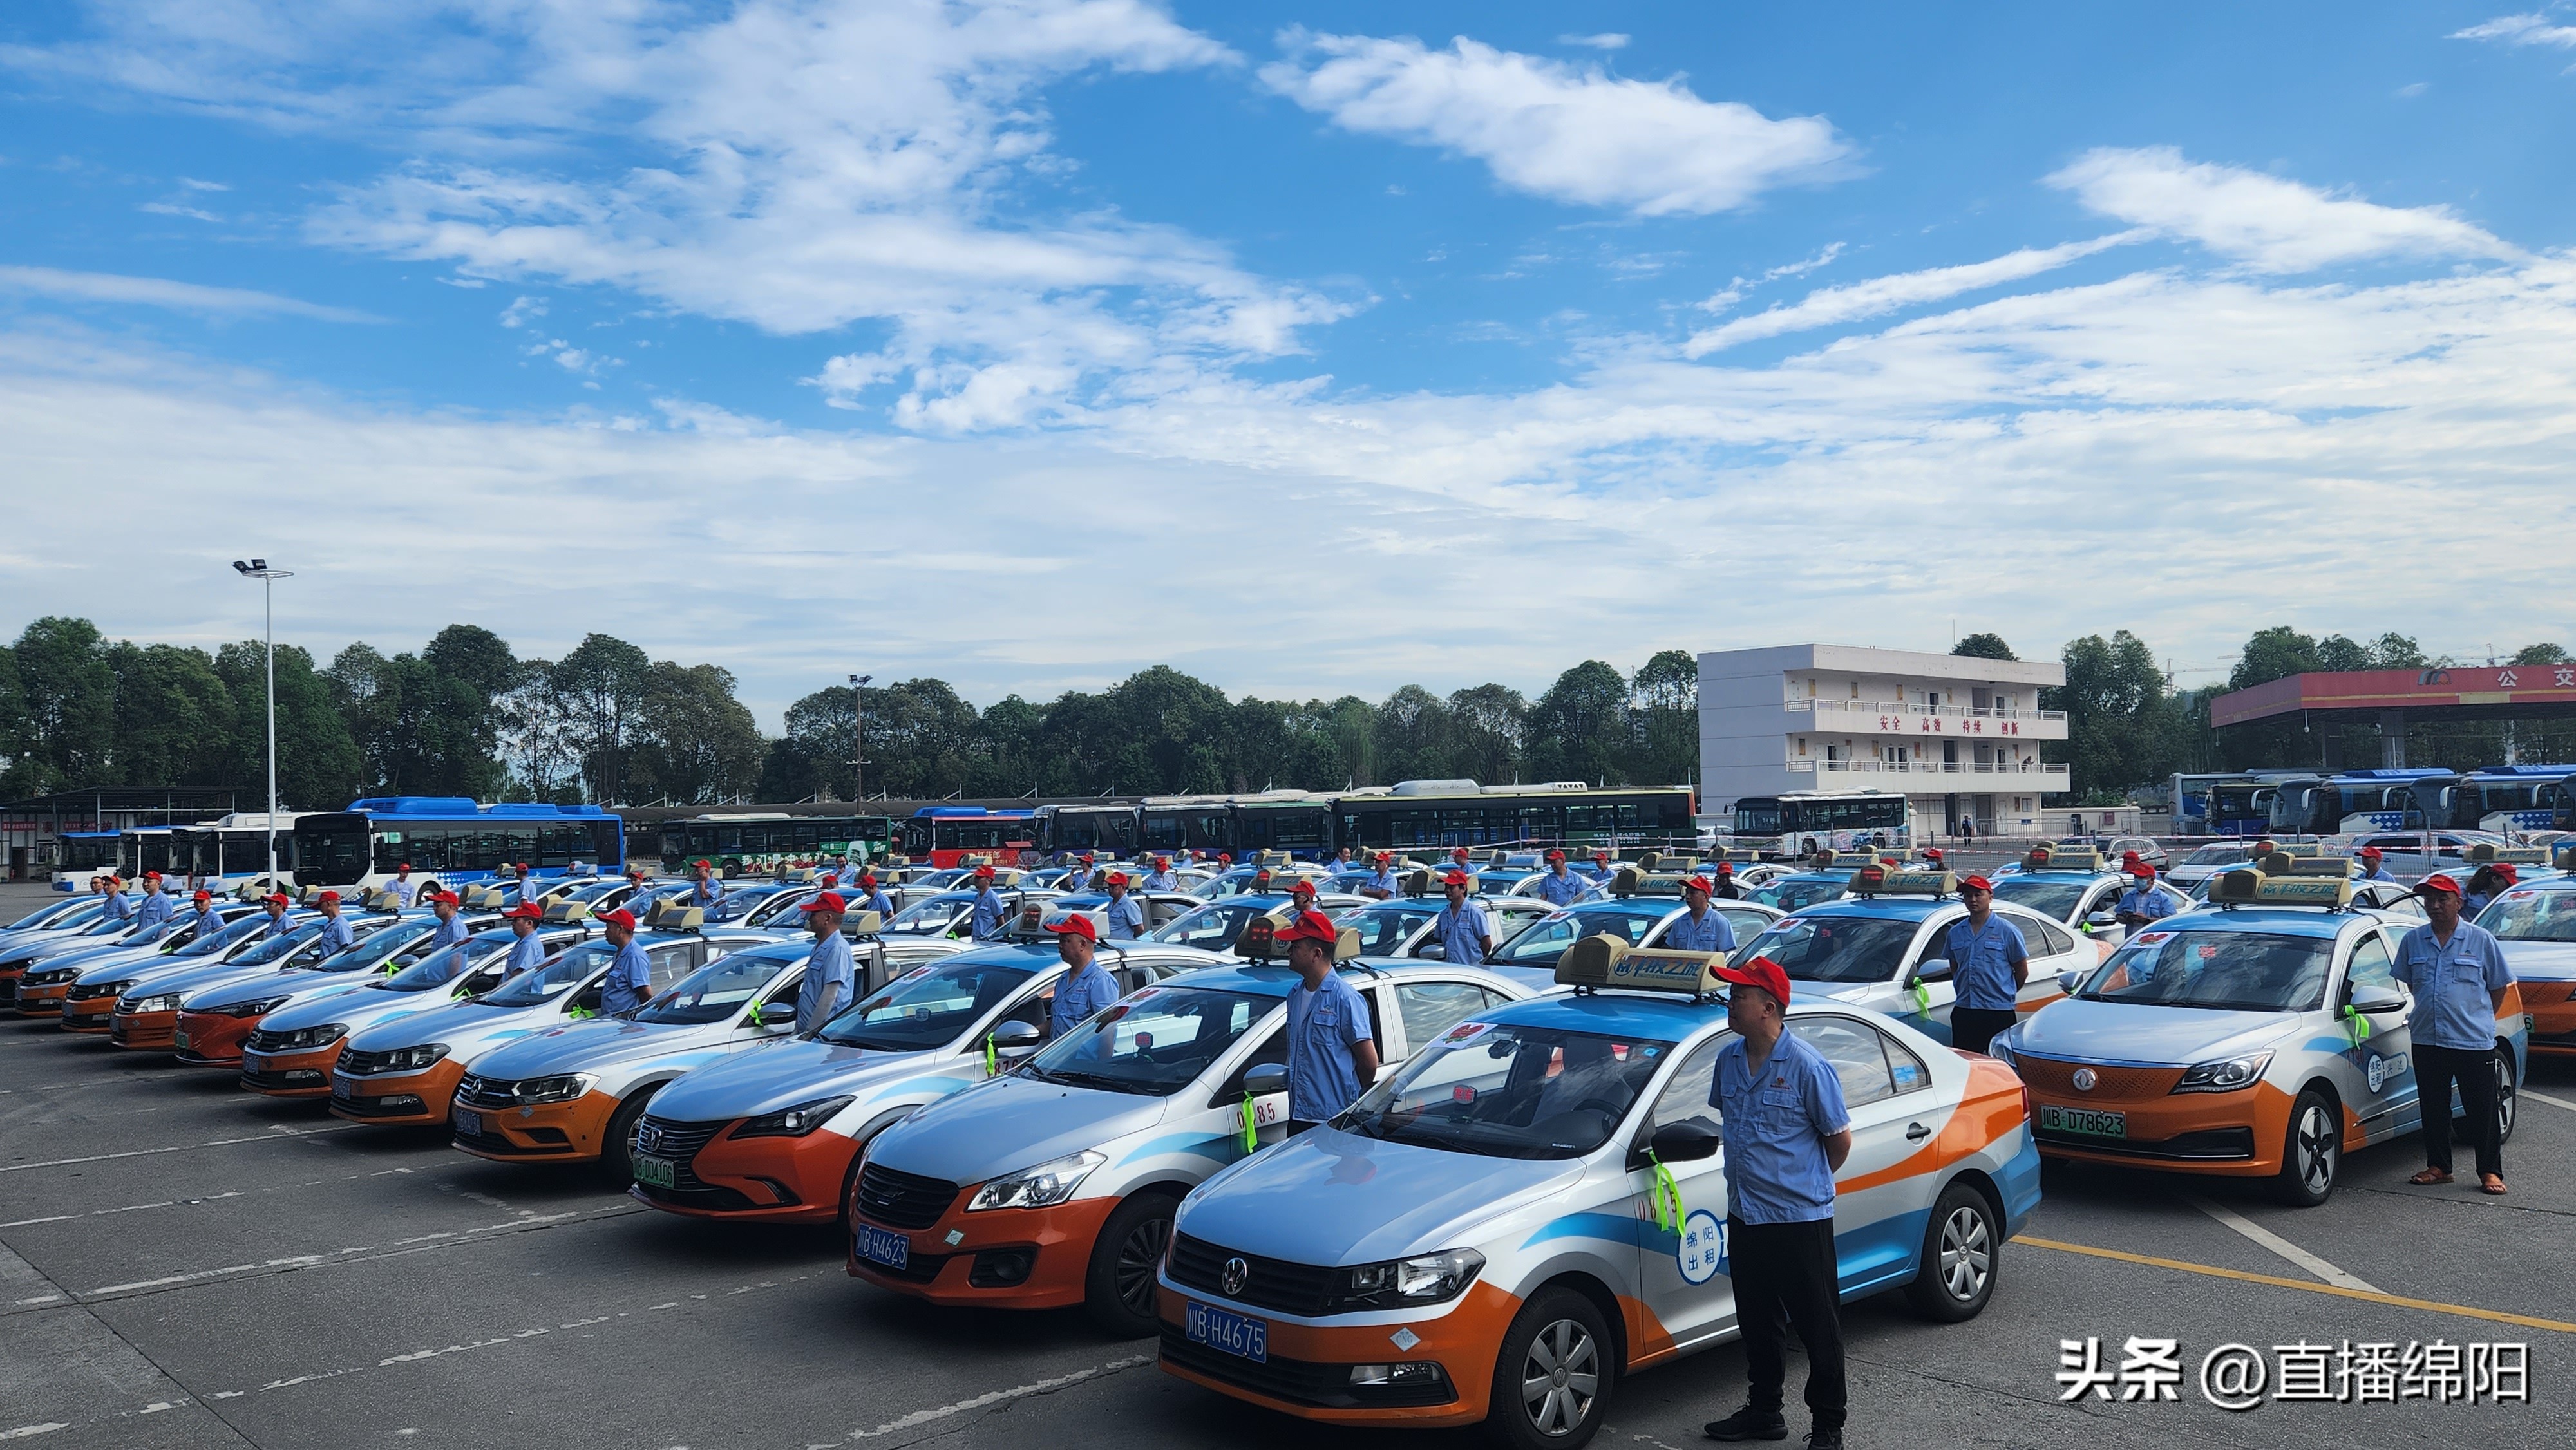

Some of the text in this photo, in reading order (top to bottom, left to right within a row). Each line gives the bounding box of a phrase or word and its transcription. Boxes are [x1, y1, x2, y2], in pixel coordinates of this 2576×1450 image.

[2497, 668, 2575, 688] 公交
[1880, 715, 2019, 736] 安全 高效 持续 创新
[1236, 1102, 1275, 1129] 085
[1638, 1191, 1678, 1222] 085
[1686, 1225, 1714, 1249] 绵阳
[1688, 1248, 1716, 1272] 出租
[1396, 1335, 1413, 1344] CNG
